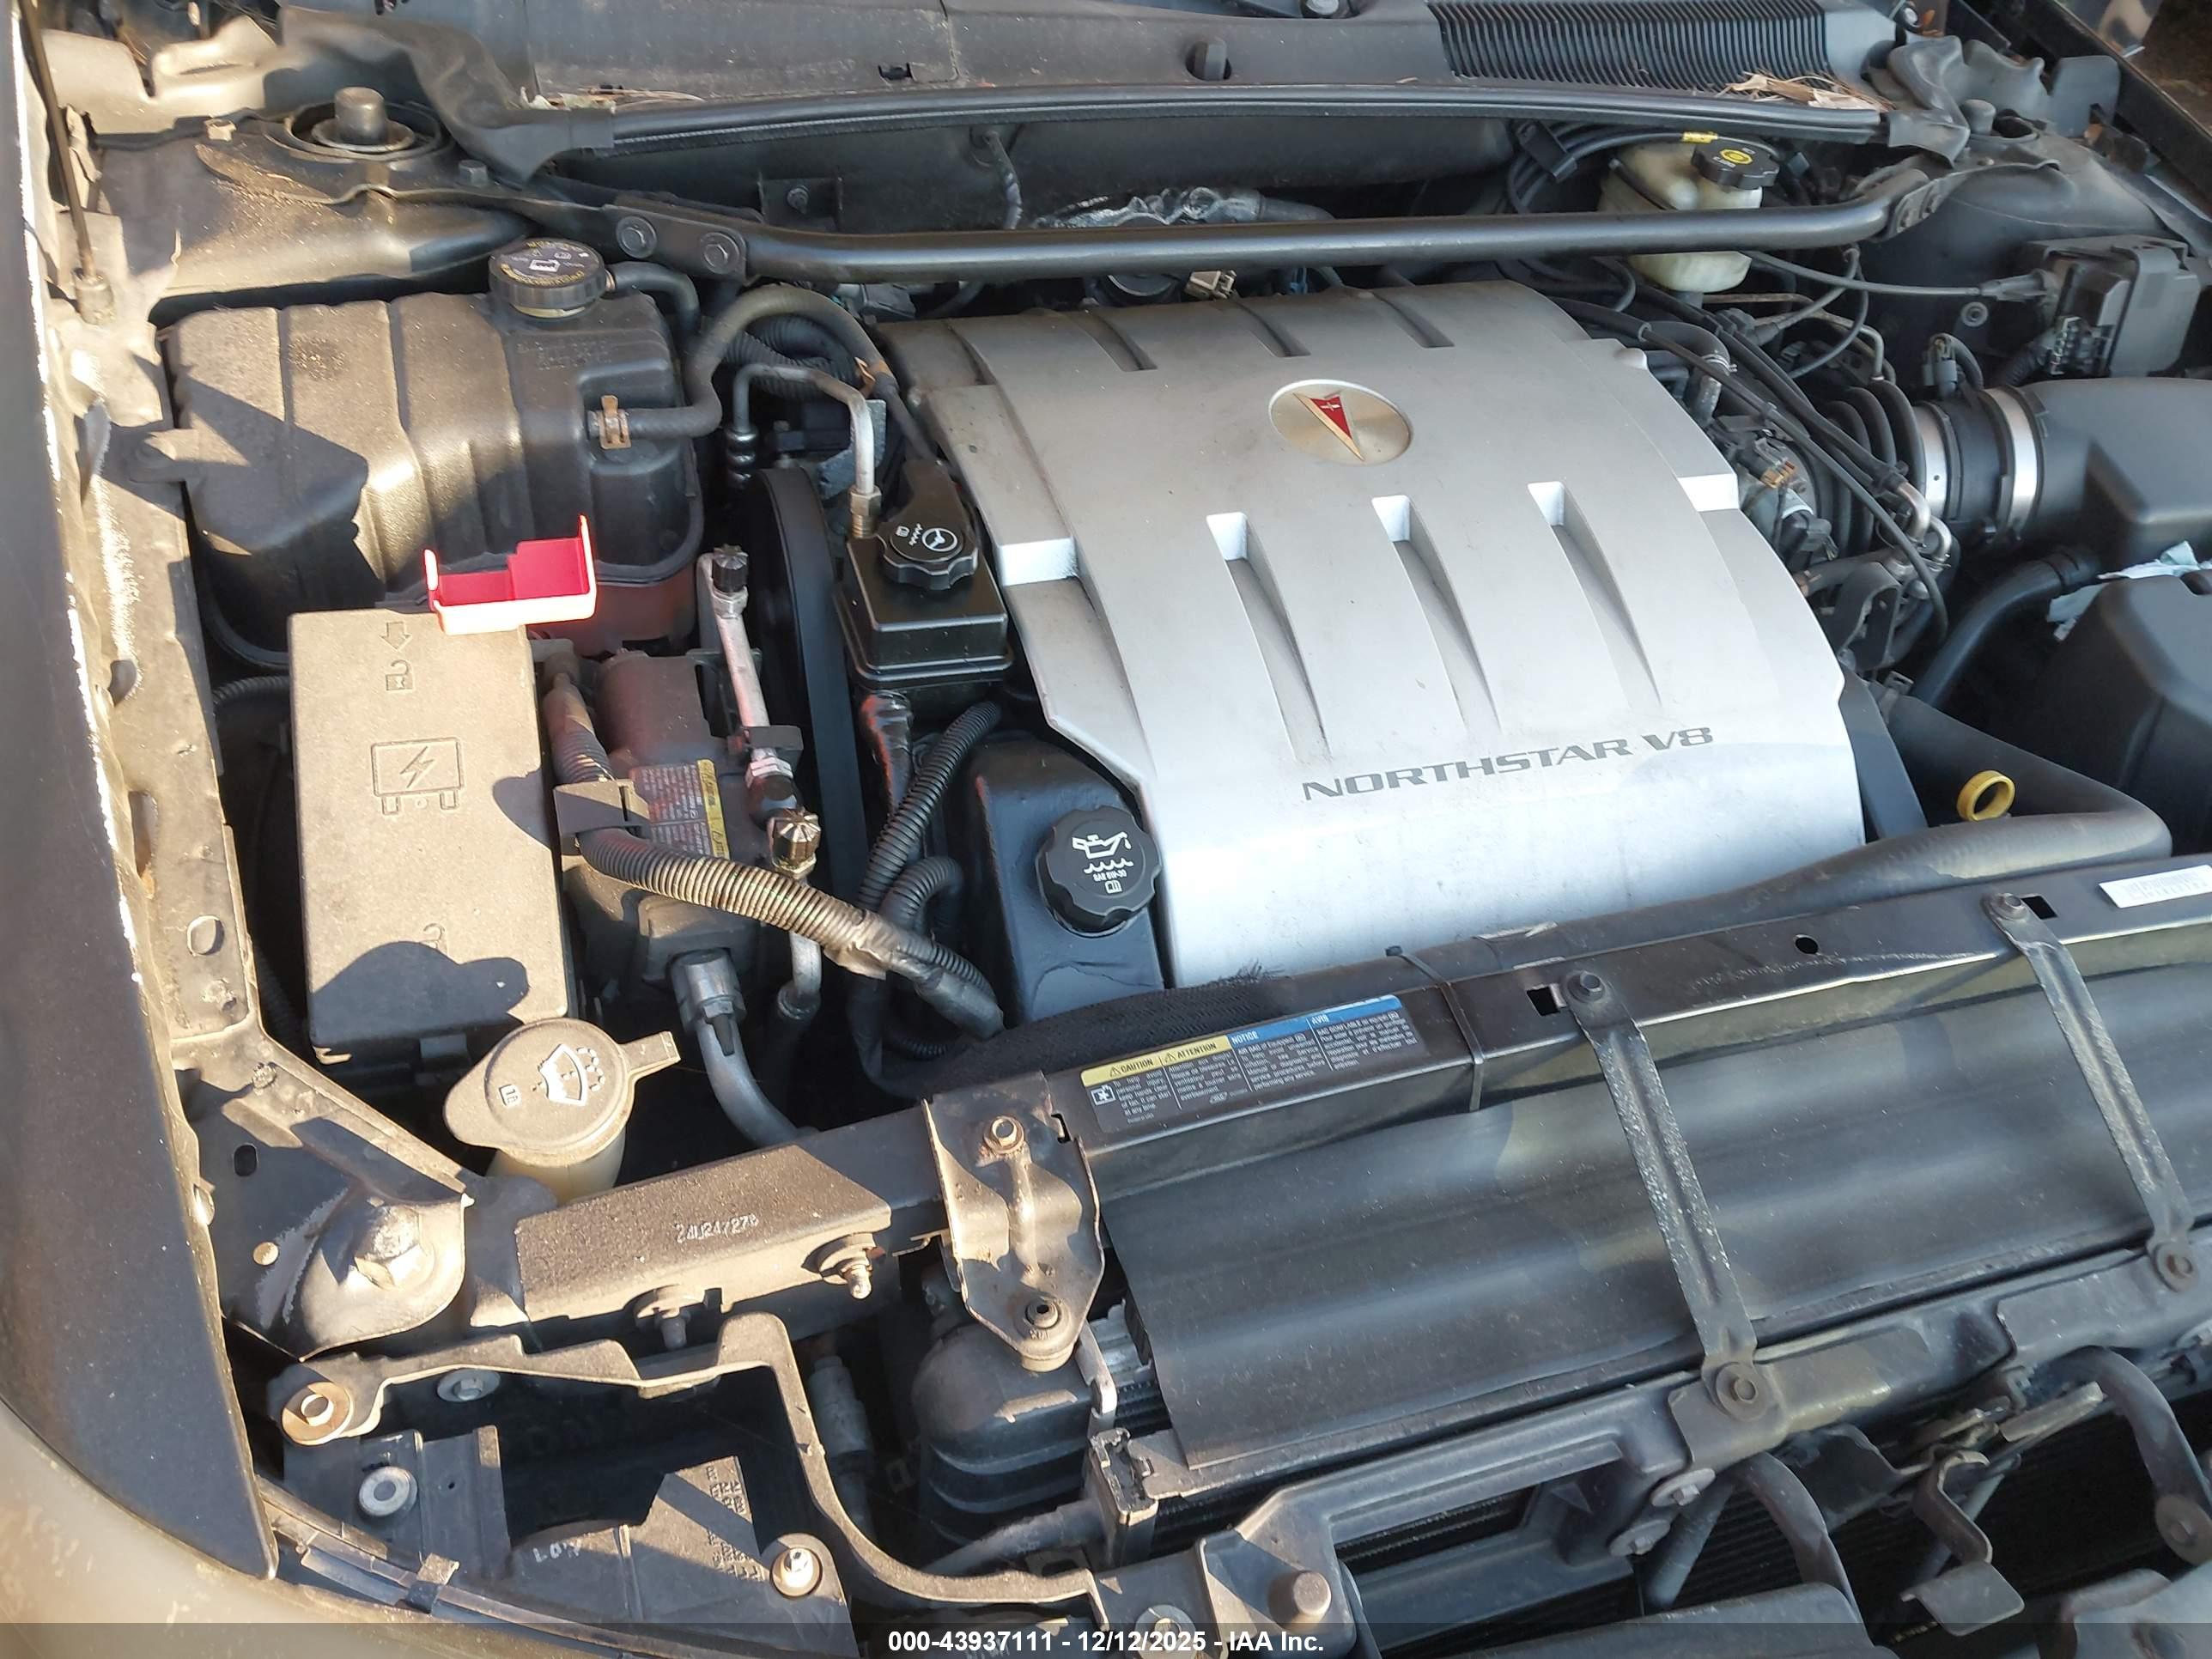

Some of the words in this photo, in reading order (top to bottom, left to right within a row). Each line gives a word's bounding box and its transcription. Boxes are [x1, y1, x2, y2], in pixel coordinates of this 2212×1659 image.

[1302, 739, 1632, 800] NORTHSTAR
[1641, 727, 1714, 751] V8
[1231, 1031, 1259, 1044] NOTICE
[1176, 1043, 1217, 1058] ATTENTION
[1120, 1059, 1153, 1073] CAUTION
